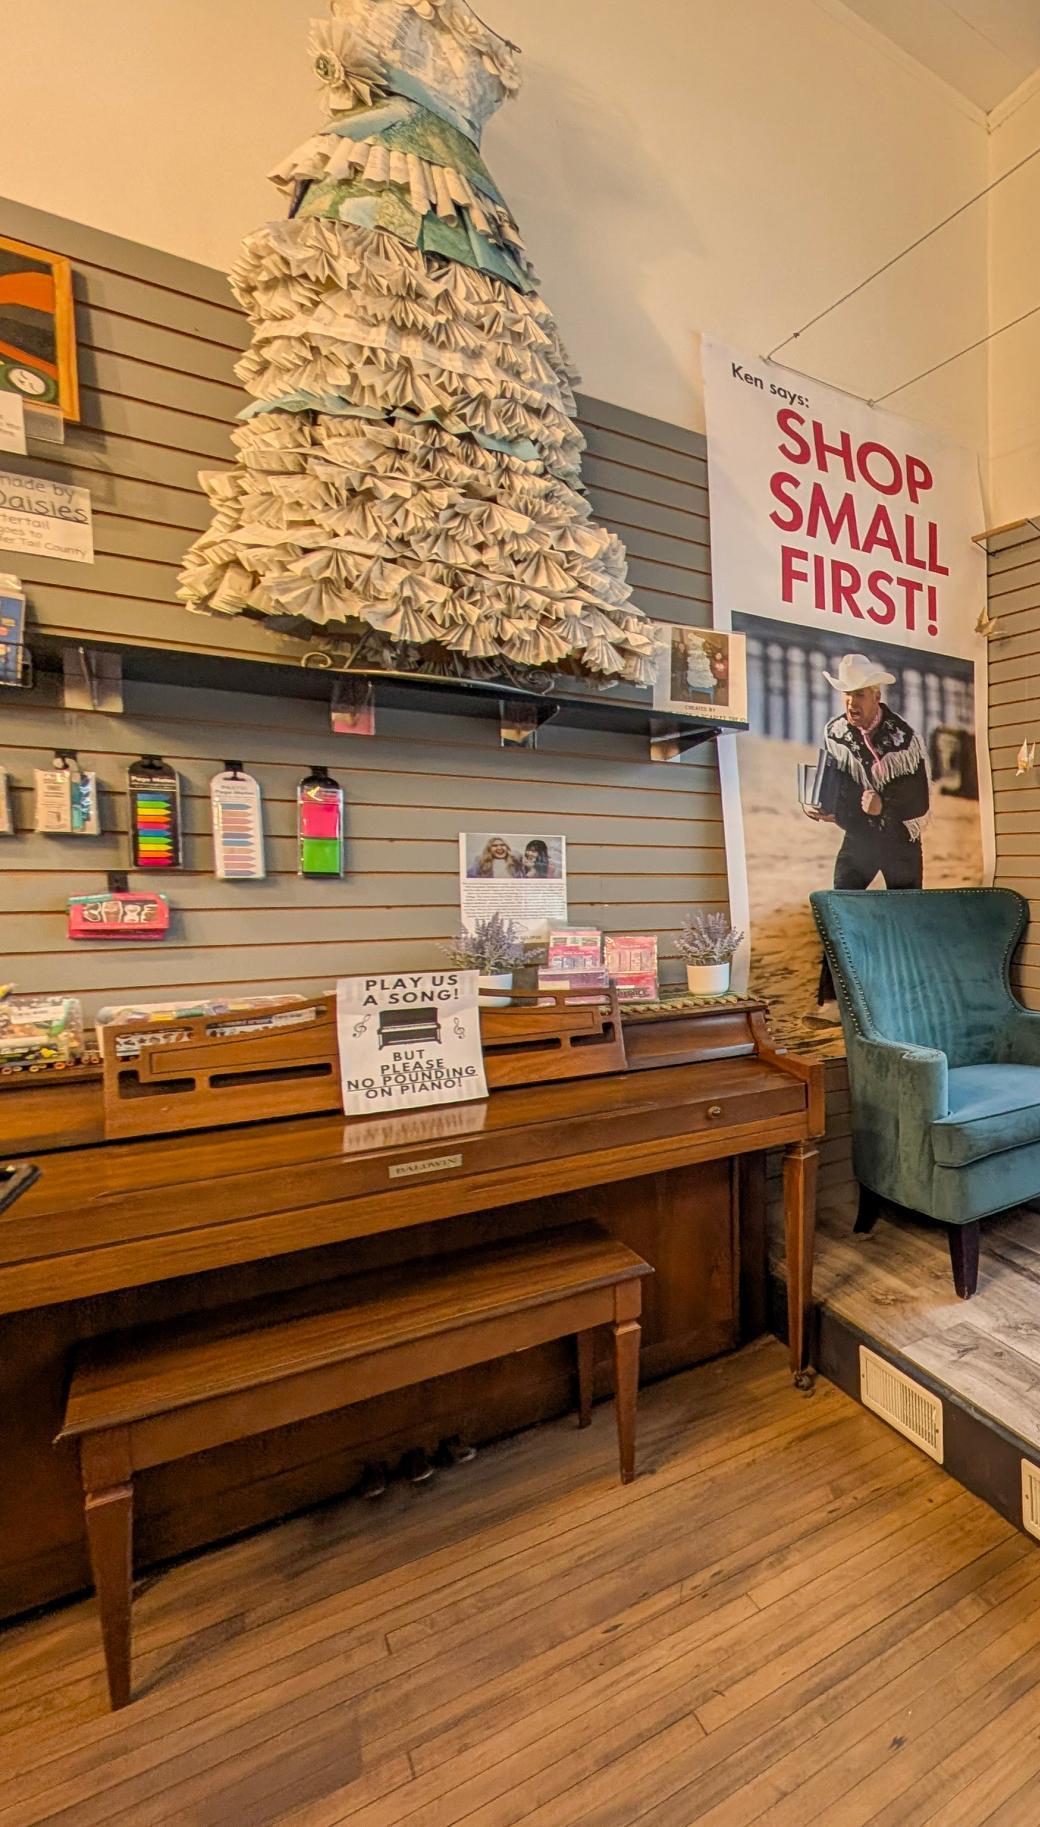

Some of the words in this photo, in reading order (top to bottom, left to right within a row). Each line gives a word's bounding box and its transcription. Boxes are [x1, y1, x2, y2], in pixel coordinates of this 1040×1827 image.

[731, 363, 764, 390] Ken
[769, 383, 810, 408] says:
[776, 408, 933, 504] SHOP
[52, 484, 74, 504] by
[769, 471, 949, 576] SMALL
[781, 544, 938, 637] FIRST!
[365, 976, 422, 991] PLAY
[432, 974, 458, 987] US
[362, 994, 378, 1006] A
[388, 988, 459, 1004] SONG!
[393, 1049, 425, 1061] BUT
[380, 1058, 444, 1074] PLEASE
[347, 1078, 374, 1090] NO
[383, 1066, 476, 1086] POUNDING
[366, 1087, 392, 1099] ON
[400, 1077, 462, 1095] PIANO!
[395, 1158, 457, 1174] BALDWIN
